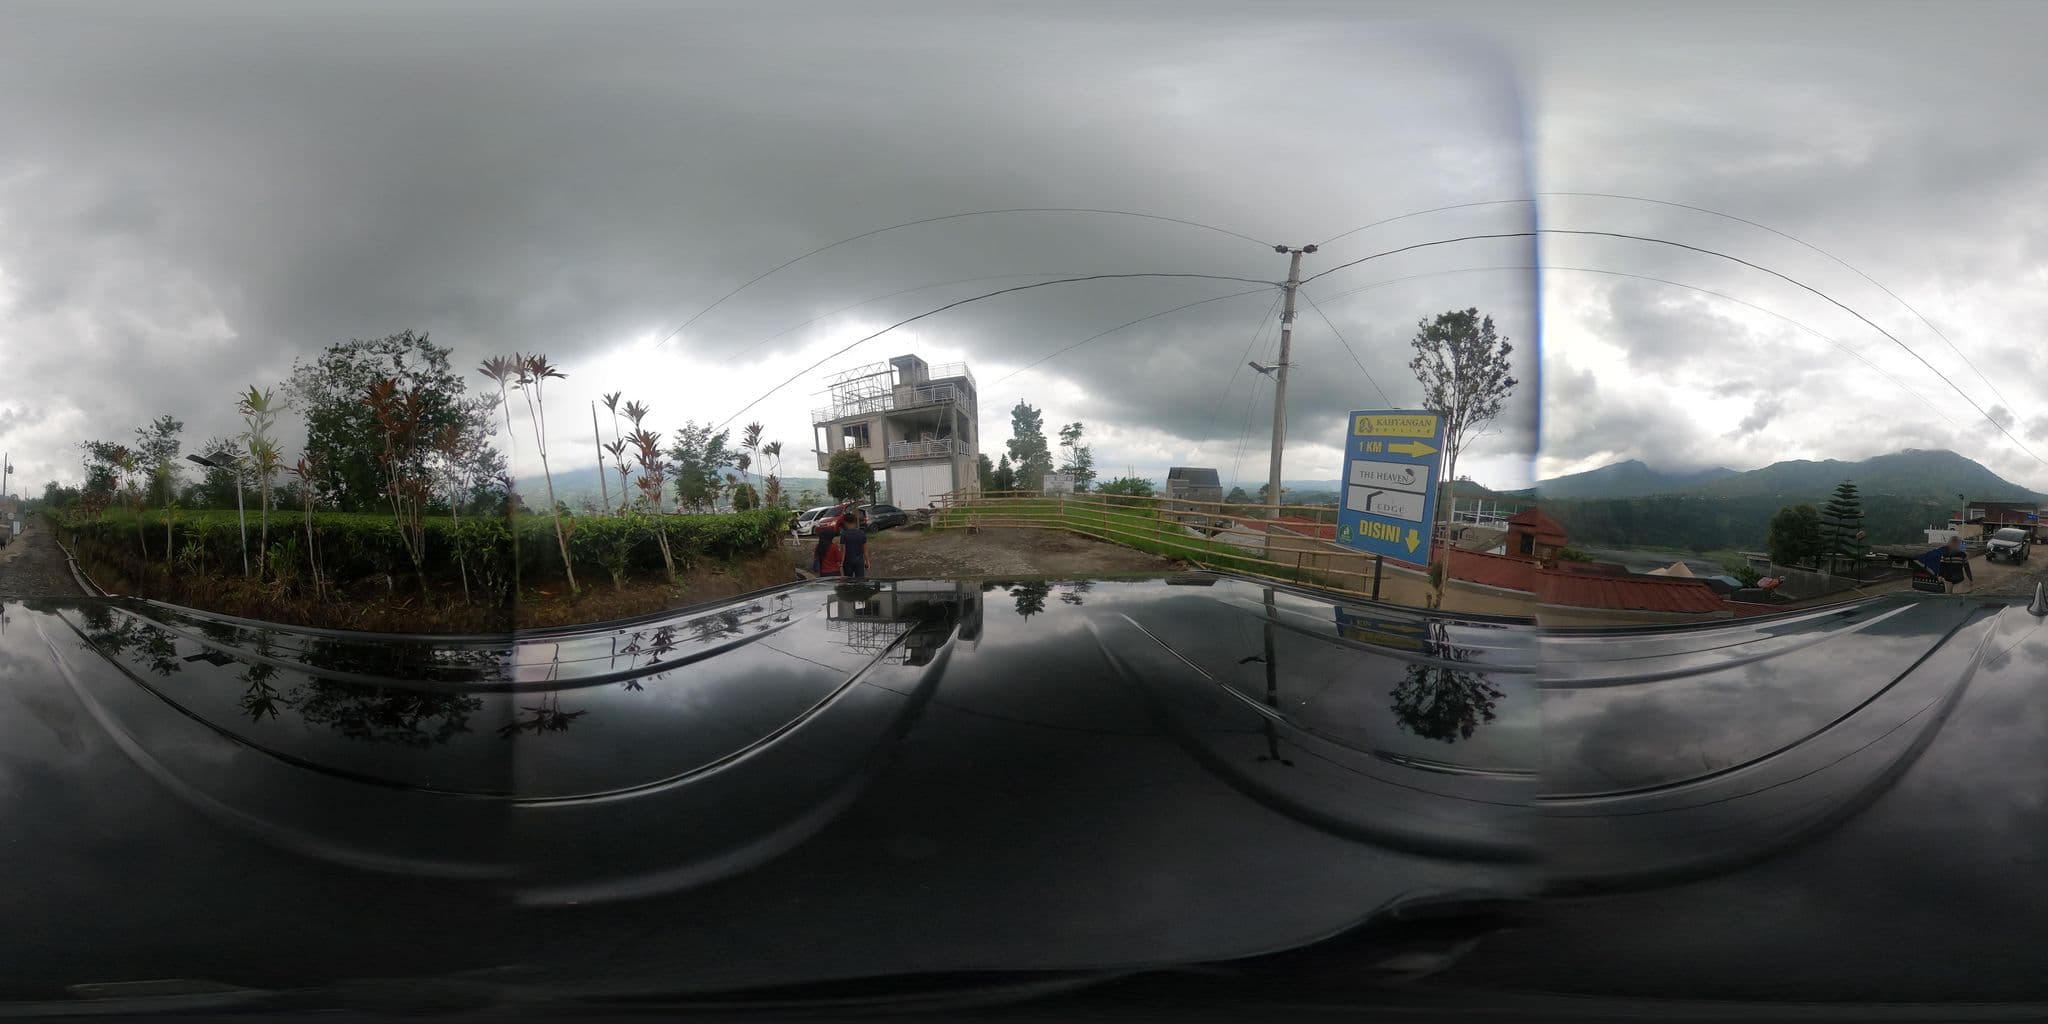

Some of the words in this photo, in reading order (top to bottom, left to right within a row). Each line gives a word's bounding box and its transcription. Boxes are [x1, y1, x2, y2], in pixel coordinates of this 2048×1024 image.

[1376, 418, 1432, 426] KAHYANGAN
[1359, 441, 1363, 452] 1
[1366, 441, 1382, 453] KM
[1360, 470, 1375, 479] THE
[1376, 472, 1409, 483] HEAVEN
[1359, 519, 1401, 543] DISINI
